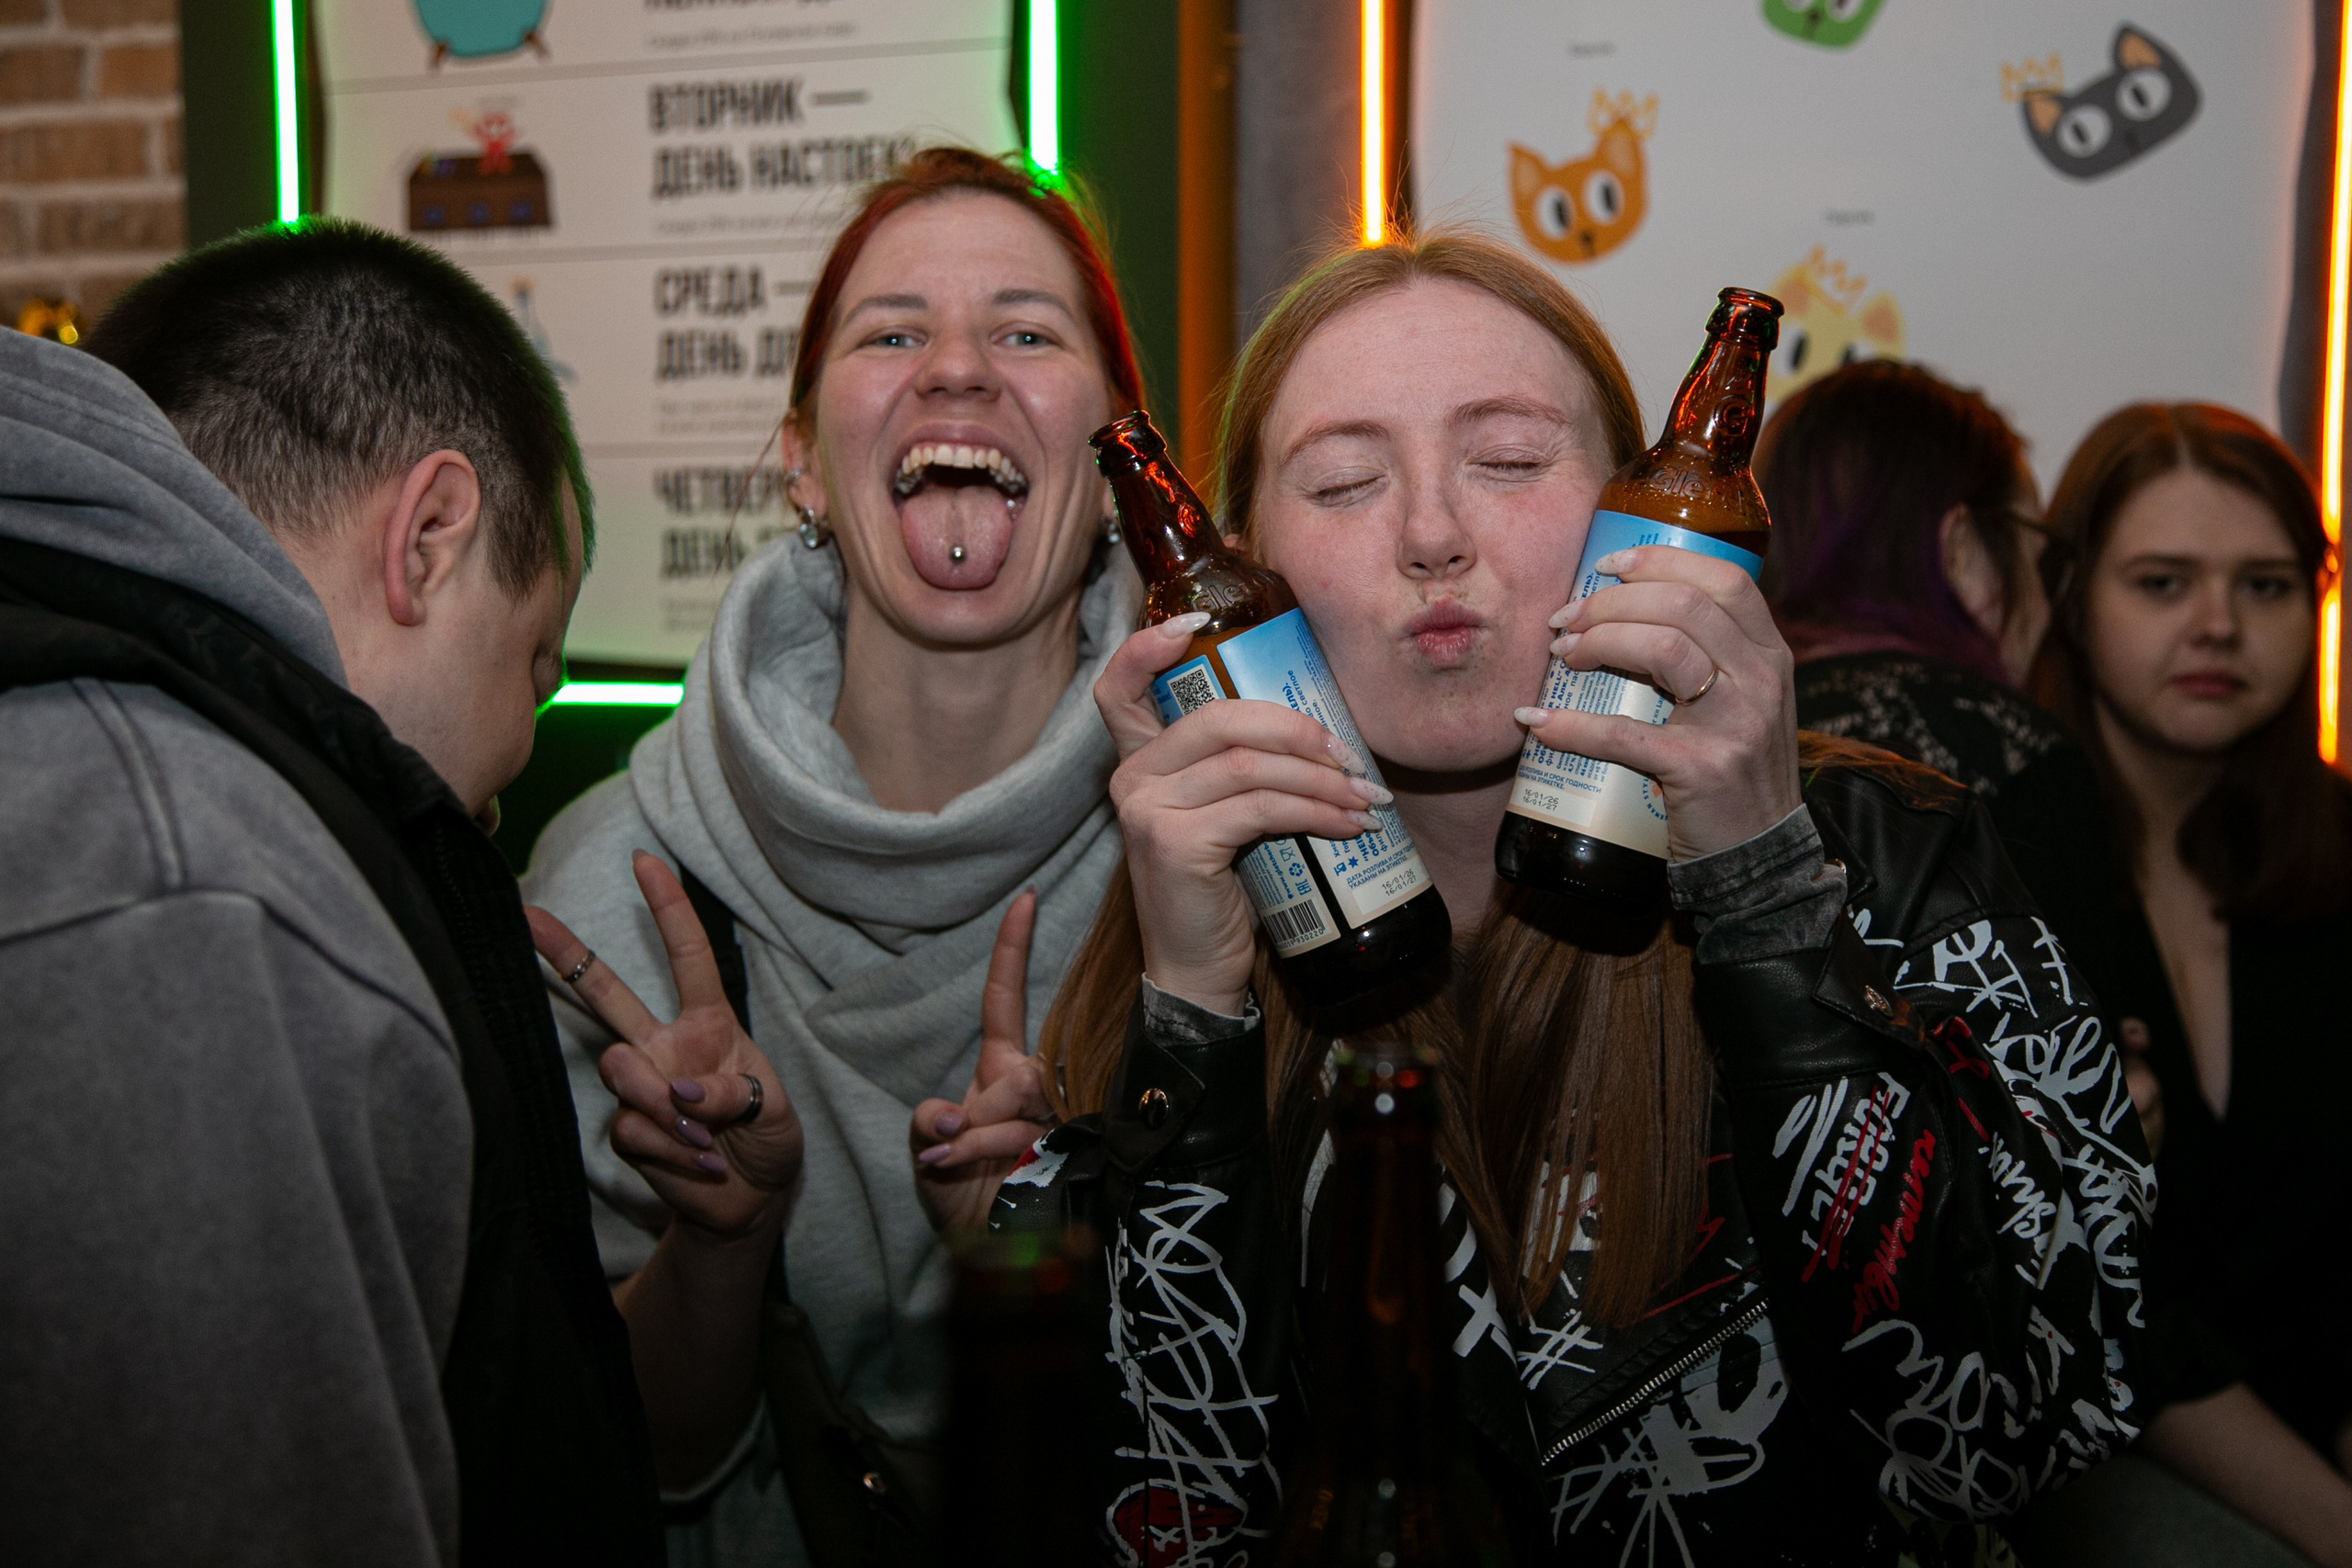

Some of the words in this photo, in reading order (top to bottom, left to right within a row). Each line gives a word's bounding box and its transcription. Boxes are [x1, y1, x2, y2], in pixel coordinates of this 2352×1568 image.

[649, 77, 805, 131] ВТОРНИК
[651, 143, 745, 197] ДЕНЬ
[654, 263, 766, 315] СРЕДА
[655, 329, 747, 382] ДЕНЬ
[1285, 669, 1308, 705] светлое
[1524, 788, 1559, 805] 16/01/26
[1548, 773, 1565, 782] СРОК
[1565, 778, 1601, 793] ГОДНОСТИ
[1522, 795, 1556, 811] 16/01/27
[1261, 840, 1292, 895] www.gletcherbr
[1346, 871, 1363, 884] ДАТА
[1362, 857, 1388, 875] РОЗЛИВА
[1349, 871, 1377, 889] УКАЗАНЫ
[1377, 866, 1385, 874] НА
[1381, 868, 1414, 889] 16/01/26
[1385, 874, 1417, 897] 16/01/27
